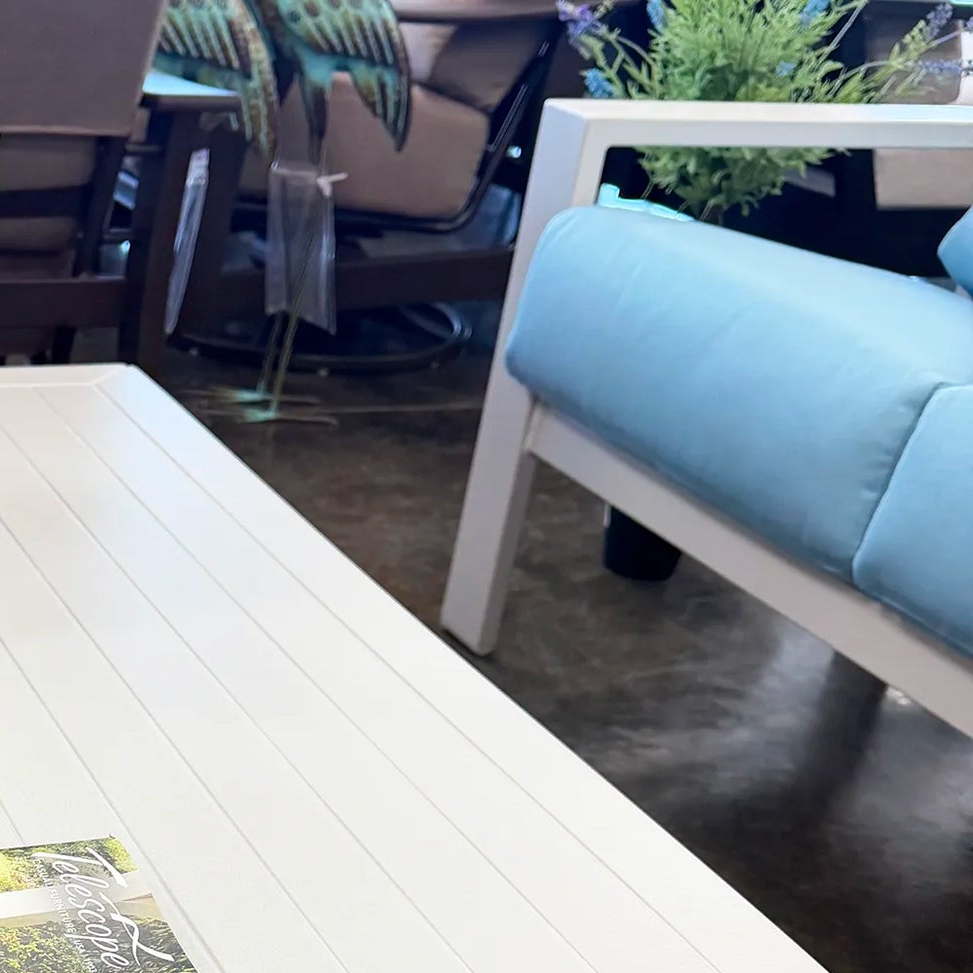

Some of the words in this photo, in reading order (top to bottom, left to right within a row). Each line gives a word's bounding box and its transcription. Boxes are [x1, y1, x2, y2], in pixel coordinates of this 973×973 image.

[31, 847, 130, 969] Telescope
[33, 858, 55, 888] CASUAL
[49, 888, 78, 934] FURNITURE
